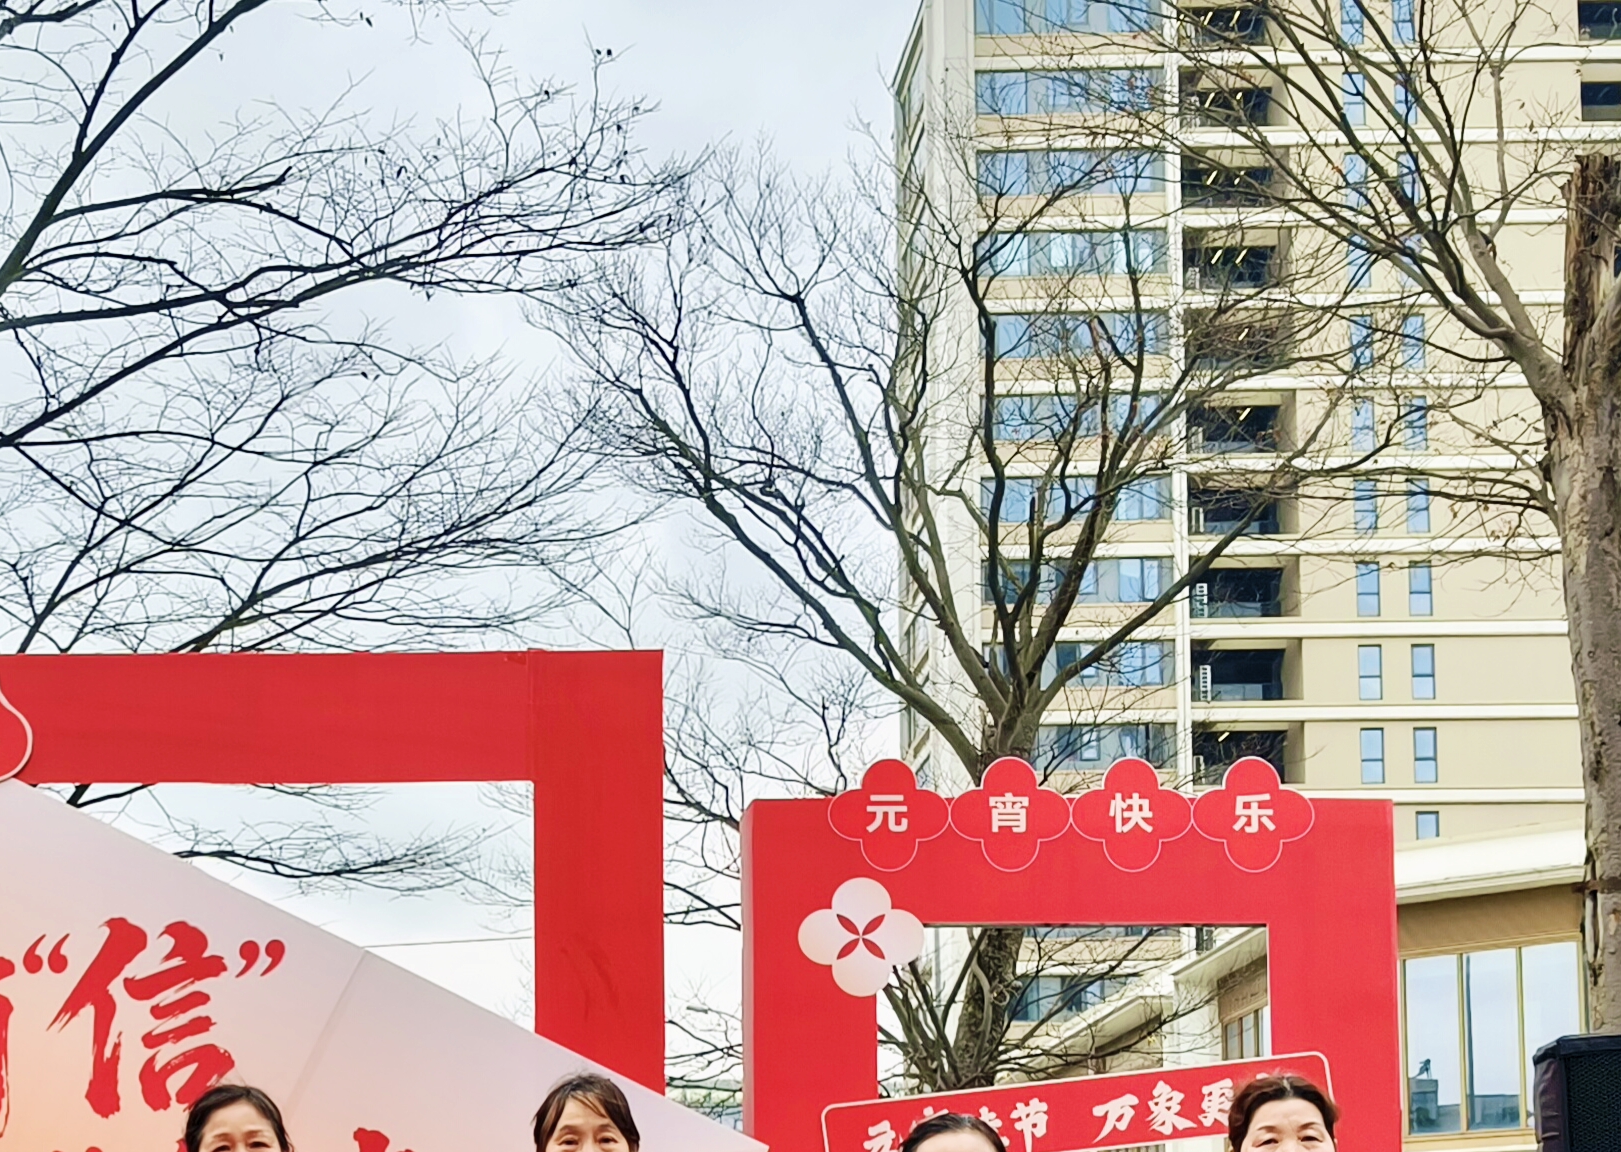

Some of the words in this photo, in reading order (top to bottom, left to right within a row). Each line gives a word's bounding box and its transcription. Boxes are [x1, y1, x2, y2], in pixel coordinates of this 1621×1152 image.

[865, 791, 1277, 836] 元宵快乐
[1092, 1074, 1276, 1143] 万象更
